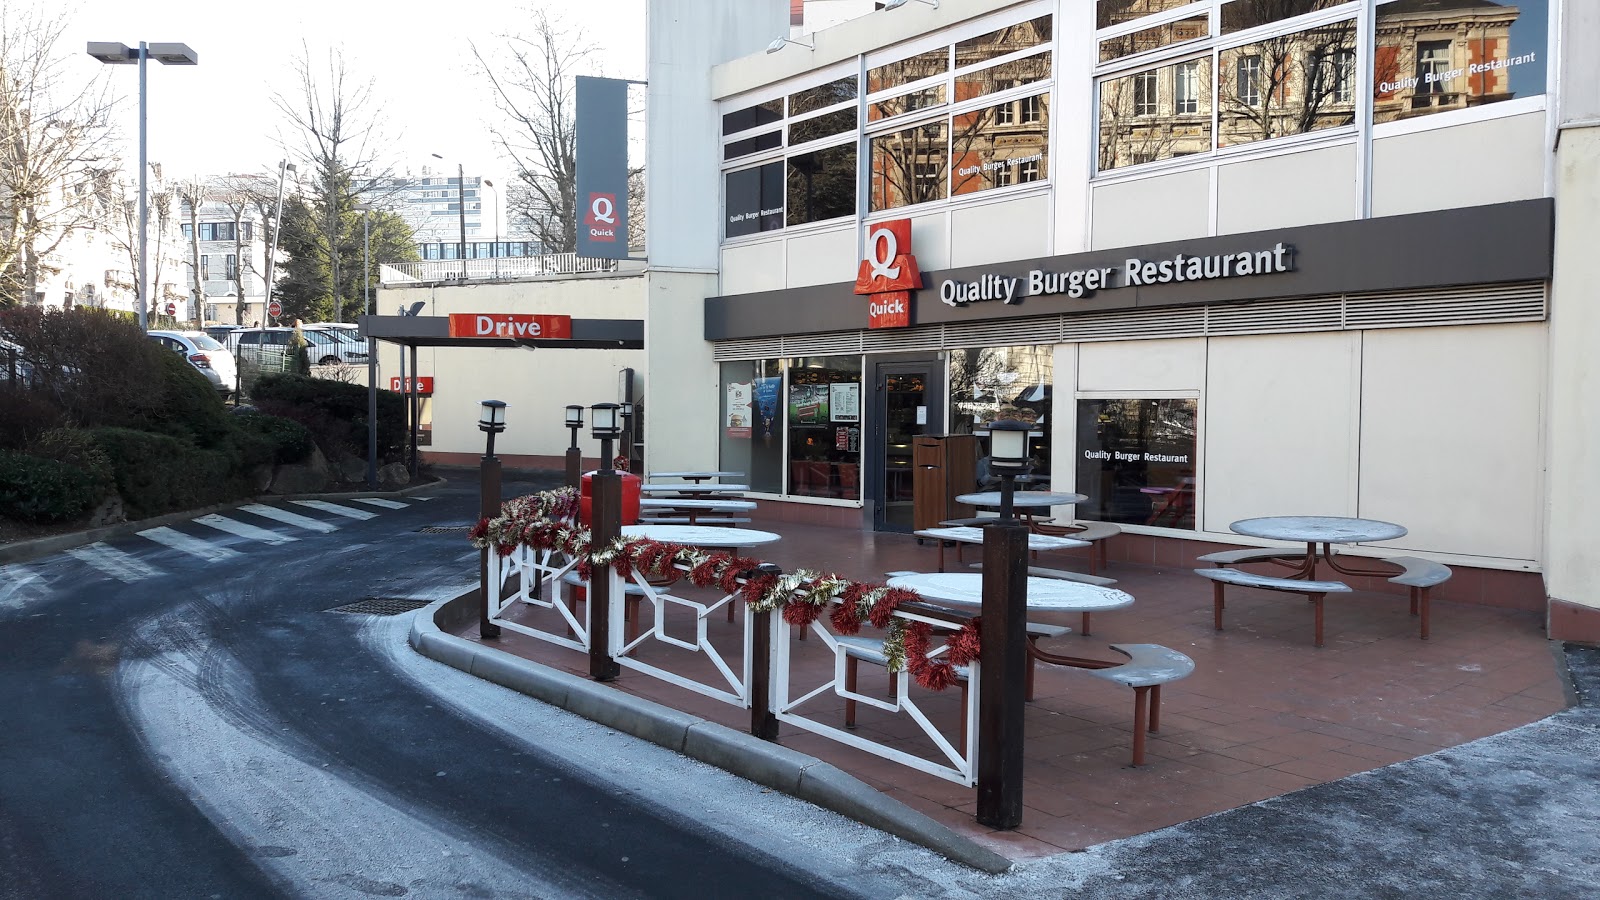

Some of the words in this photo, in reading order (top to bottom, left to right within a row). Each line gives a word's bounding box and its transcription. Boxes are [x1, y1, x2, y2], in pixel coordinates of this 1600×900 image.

[1379, 76, 1419, 93] Quality
[1424, 67, 1463, 85] Burger
[1468, 51, 1536, 74] Restaurant
[958, 166, 980, 176] Quality
[983, 161, 1005, 171] Burger
[1006, 152, 1042, 167] Restaurant
[592, 197, 615, 224] Q
[729, 213, 745, 223] Quality
[745, 211, 760, 220] Burger
[760, 206, 784, 217] Restaurant
[590, 228, 614, 238] Quick
[868, 228, 900, 280] Q
[940, 274, 1018, 307] Quality
[1028, 266, 1112, 298] Burger
[1125, 242, 1287, 286] Restaurant
[869, 299, 904, 316] Quick
[476, 315, 541, 336] Drive
[393, 378, 424, 391] Die
[1084, 449, 1111, 461] Quality
[1115, 451, 1140, 462] Burger
[1144, 452, 1188, 463] Restaurant
